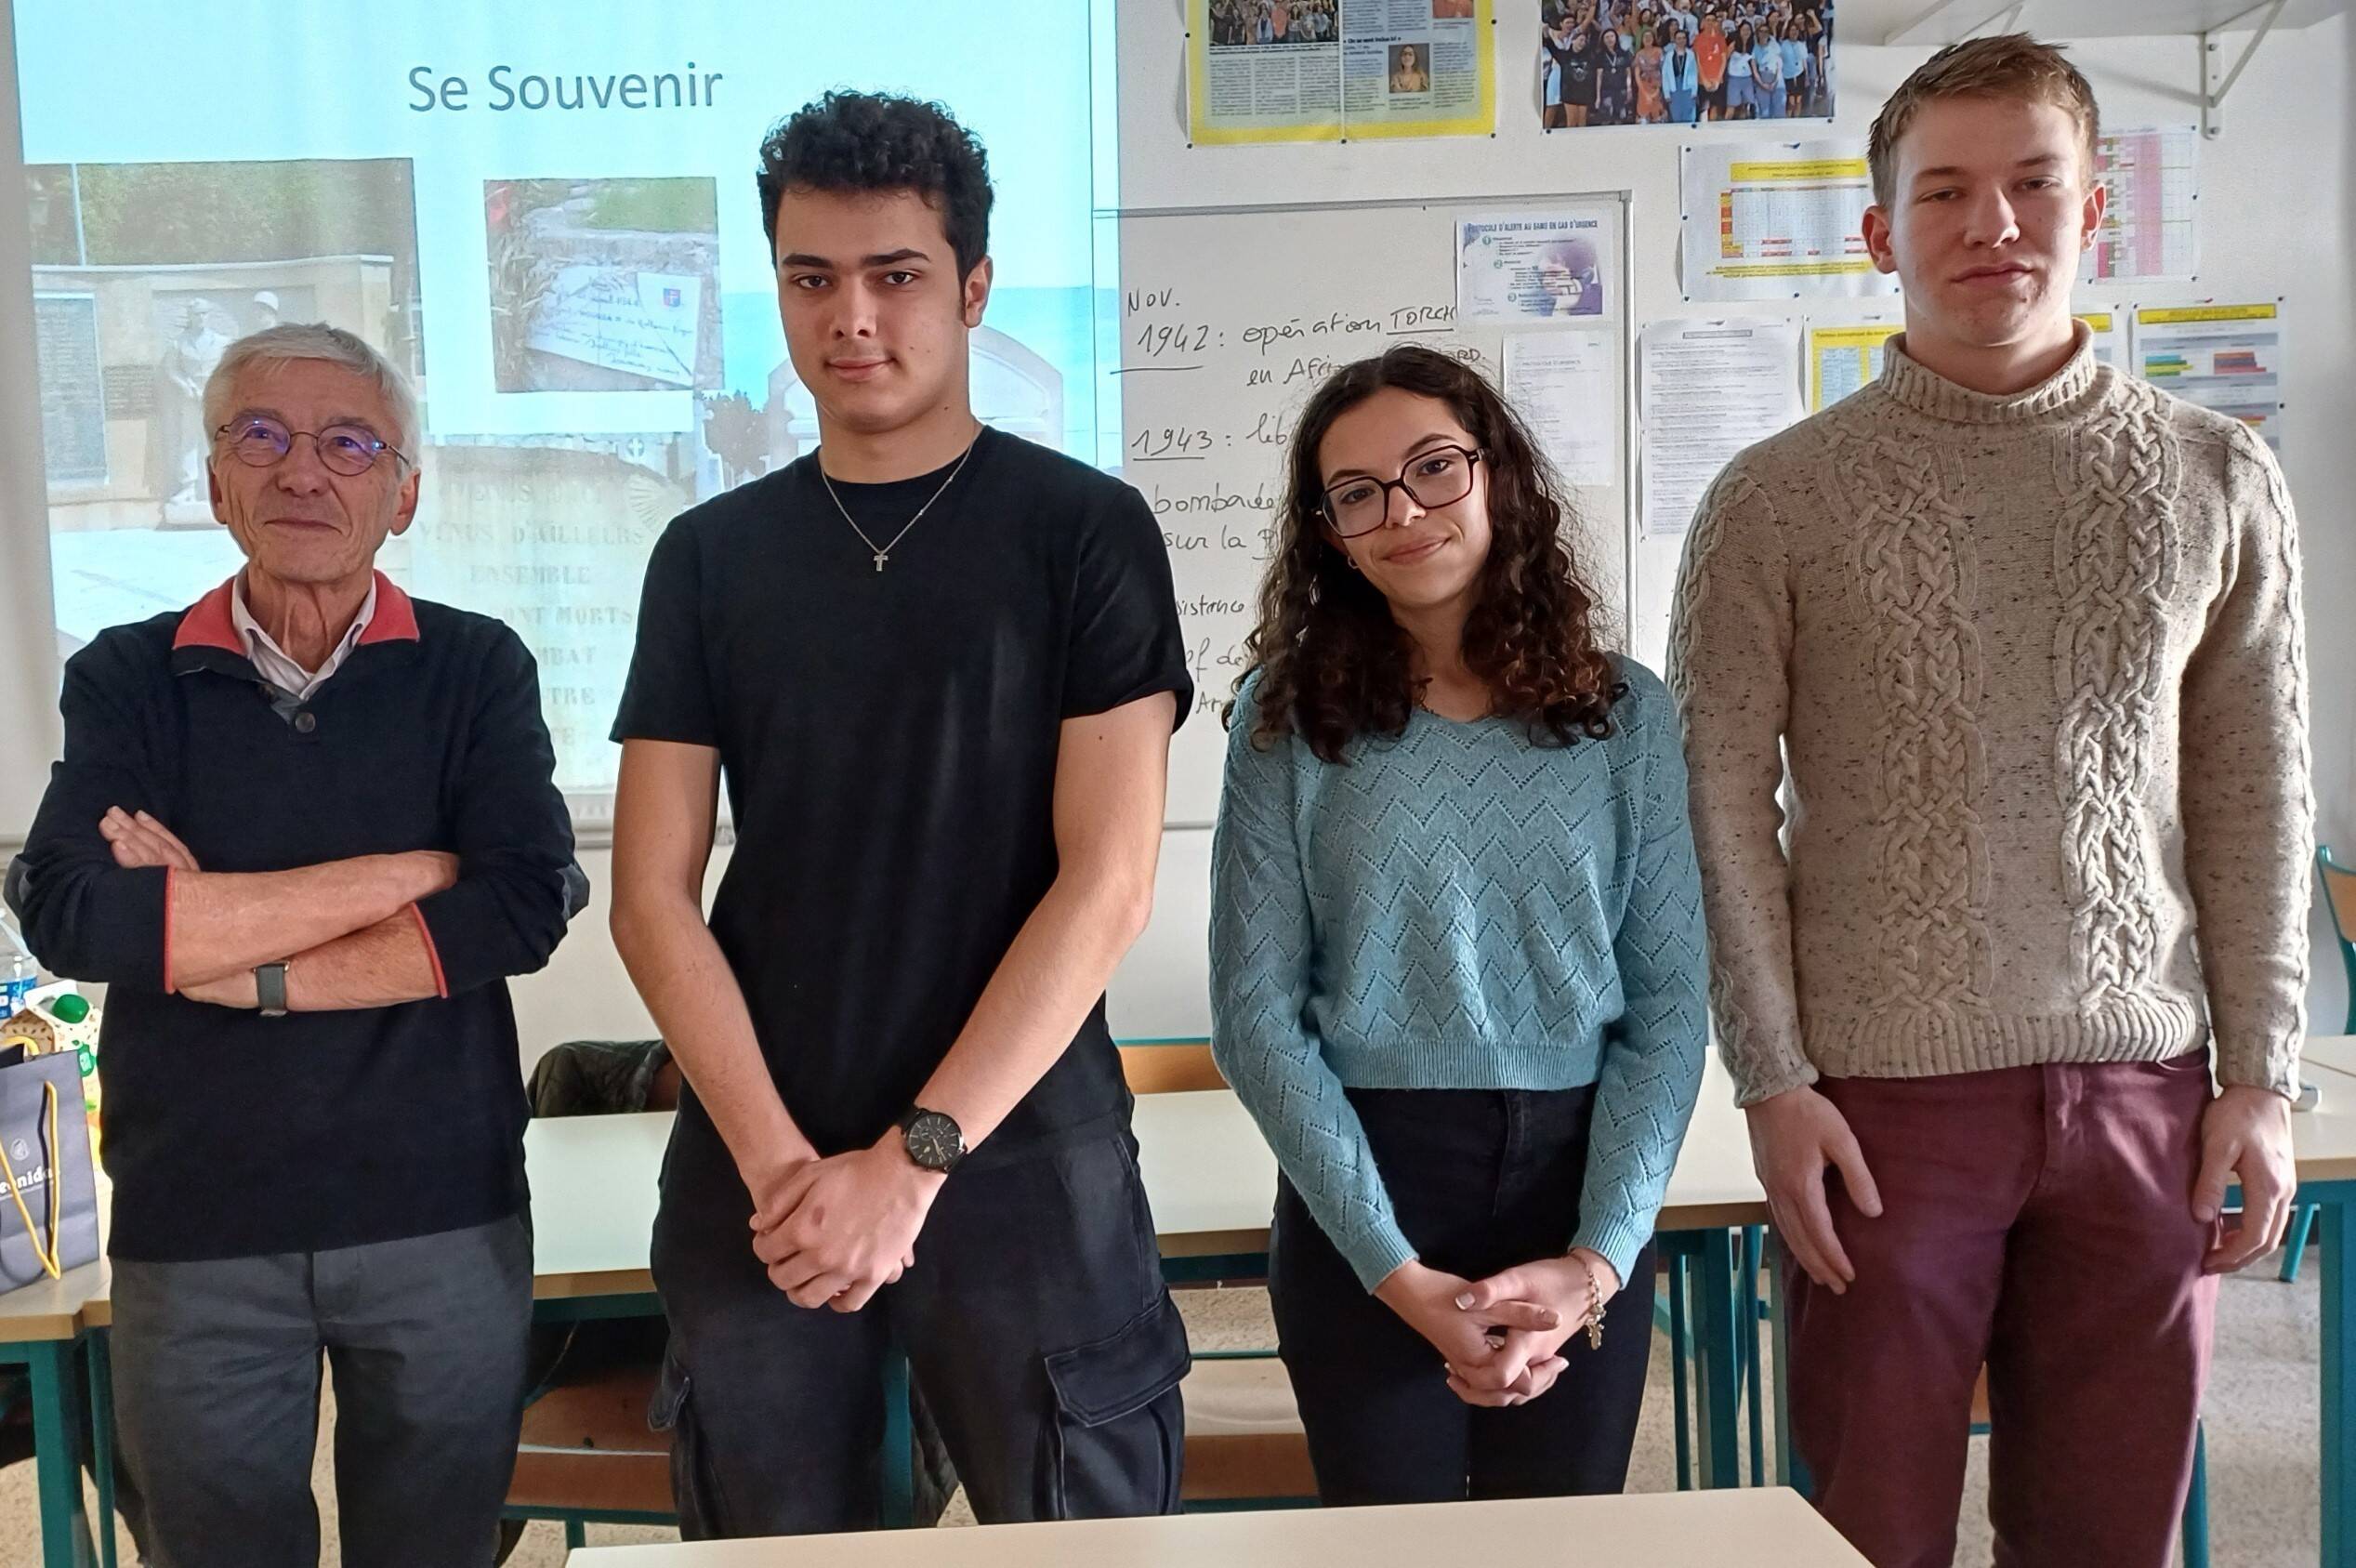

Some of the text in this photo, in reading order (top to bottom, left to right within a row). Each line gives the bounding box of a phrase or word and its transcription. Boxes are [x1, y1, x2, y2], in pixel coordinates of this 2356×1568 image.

[408, 61, 723, 112] Se Souvenir
[1390, 305, 1457, 329] TORCH
[1246, 369, 1272, 387] en
[1283, 354, 1336, 384] Afri
[1245, 413, 1288, 445] lib
[1153, 482, 1275, 514] bombarde
[1164, 532, 1209, 550] sur
[1221, 524, 1247, 549] la
[469, 565, 591, 586] ENSEMBLE
[538, 646, 597, 666] MBAT
[548, 686, 597, 705] TRE
